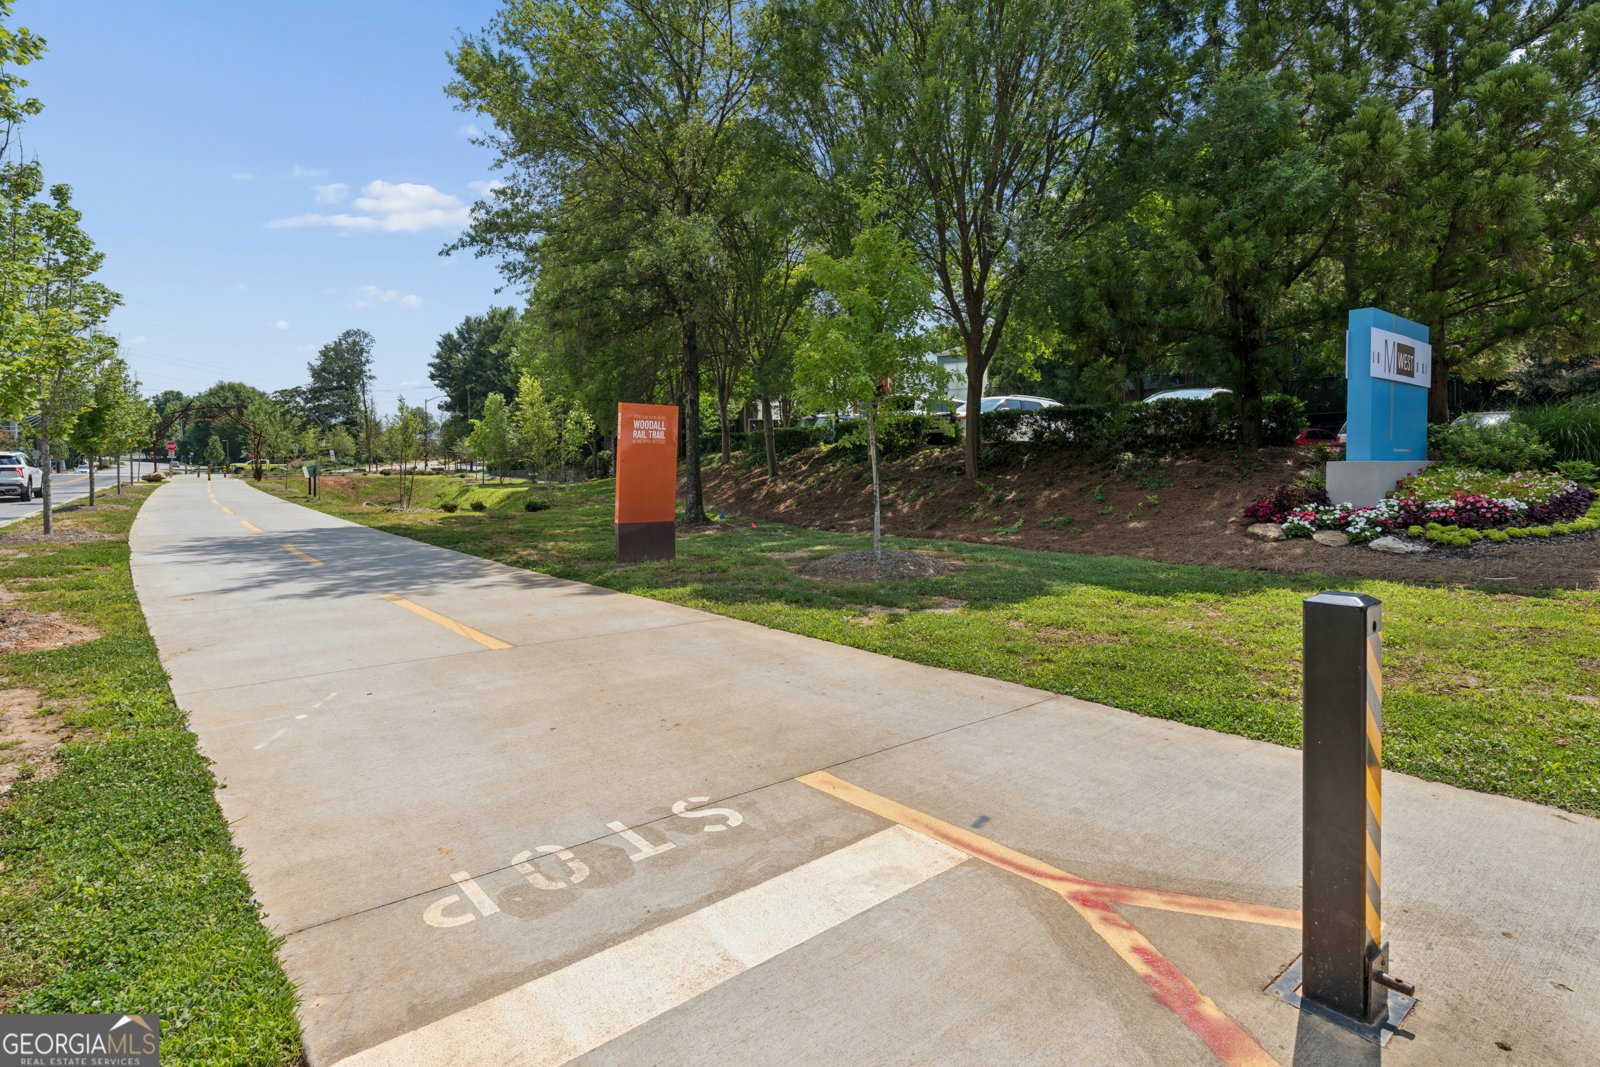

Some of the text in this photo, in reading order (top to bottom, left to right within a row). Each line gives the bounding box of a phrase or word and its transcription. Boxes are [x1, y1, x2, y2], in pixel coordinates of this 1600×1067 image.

[1397, 351, 1414, 372] WEST
[633, 419, 666, 431] WOODALL
[632, 430, 666, 440] RAIL TRAIL
[422, 796, 744, 928] STOP
